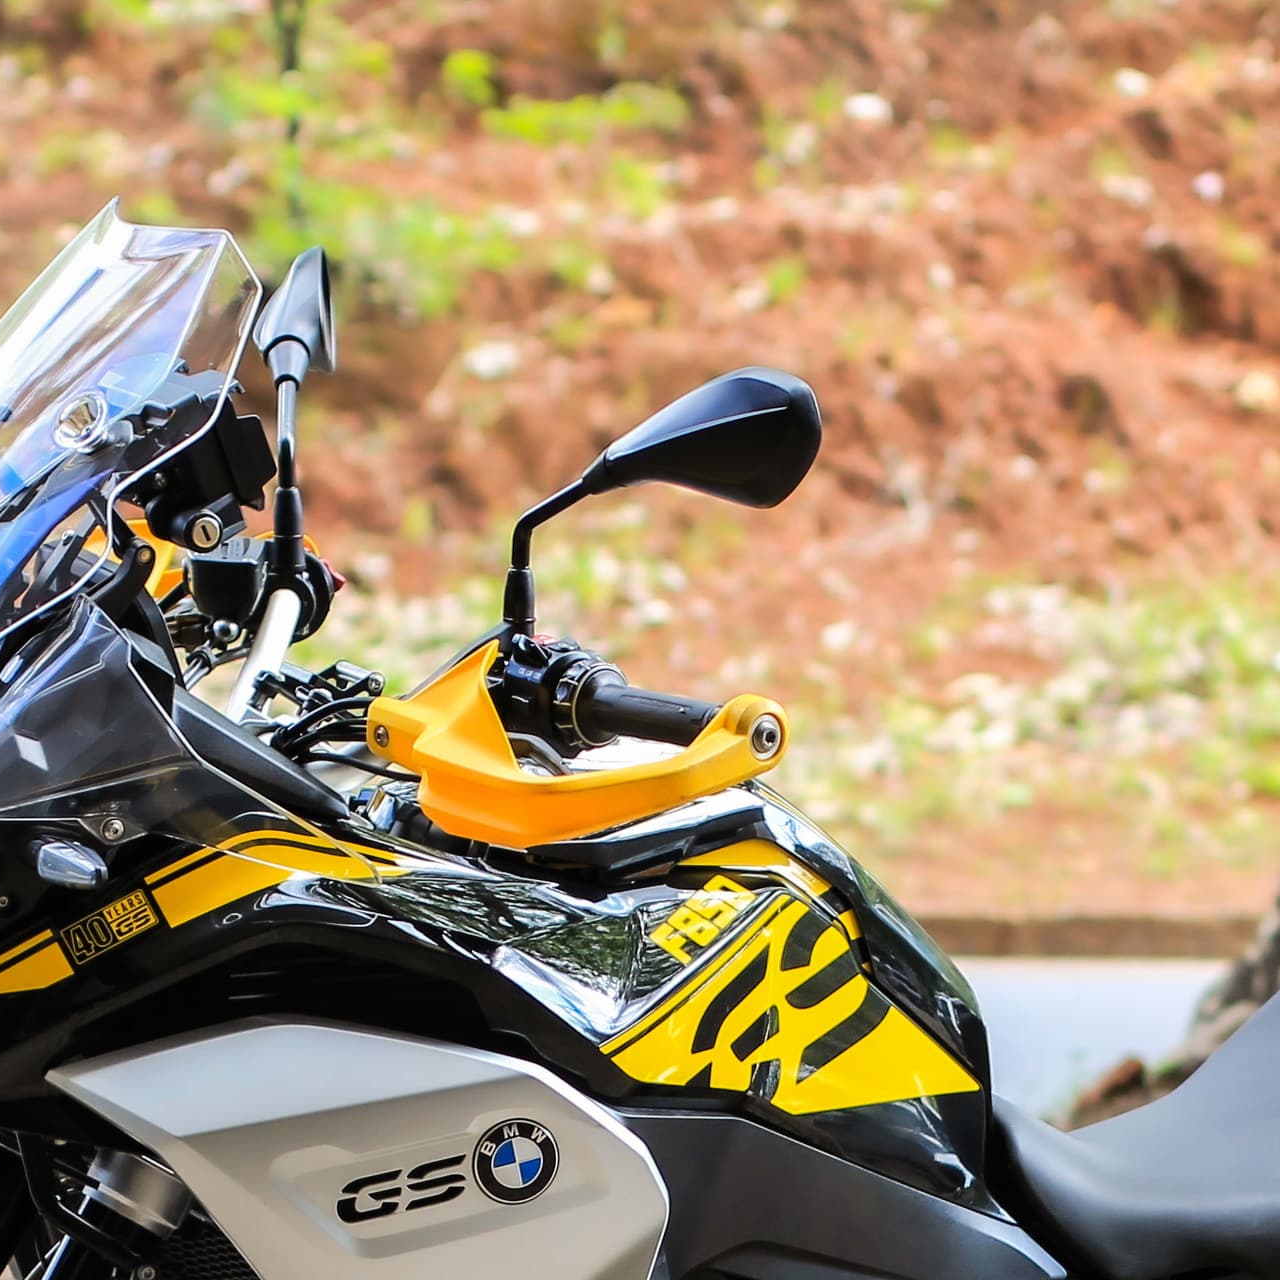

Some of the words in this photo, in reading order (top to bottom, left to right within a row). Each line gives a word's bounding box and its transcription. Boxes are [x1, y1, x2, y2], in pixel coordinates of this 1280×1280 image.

[105, 894, 144, 919] YEARS
[115, 907, 151, 937] GS
[70, 916, 113, 956] 40
[480, 1122, 548, 1157] BMW
[336, 1153, 467, 1224] GS
